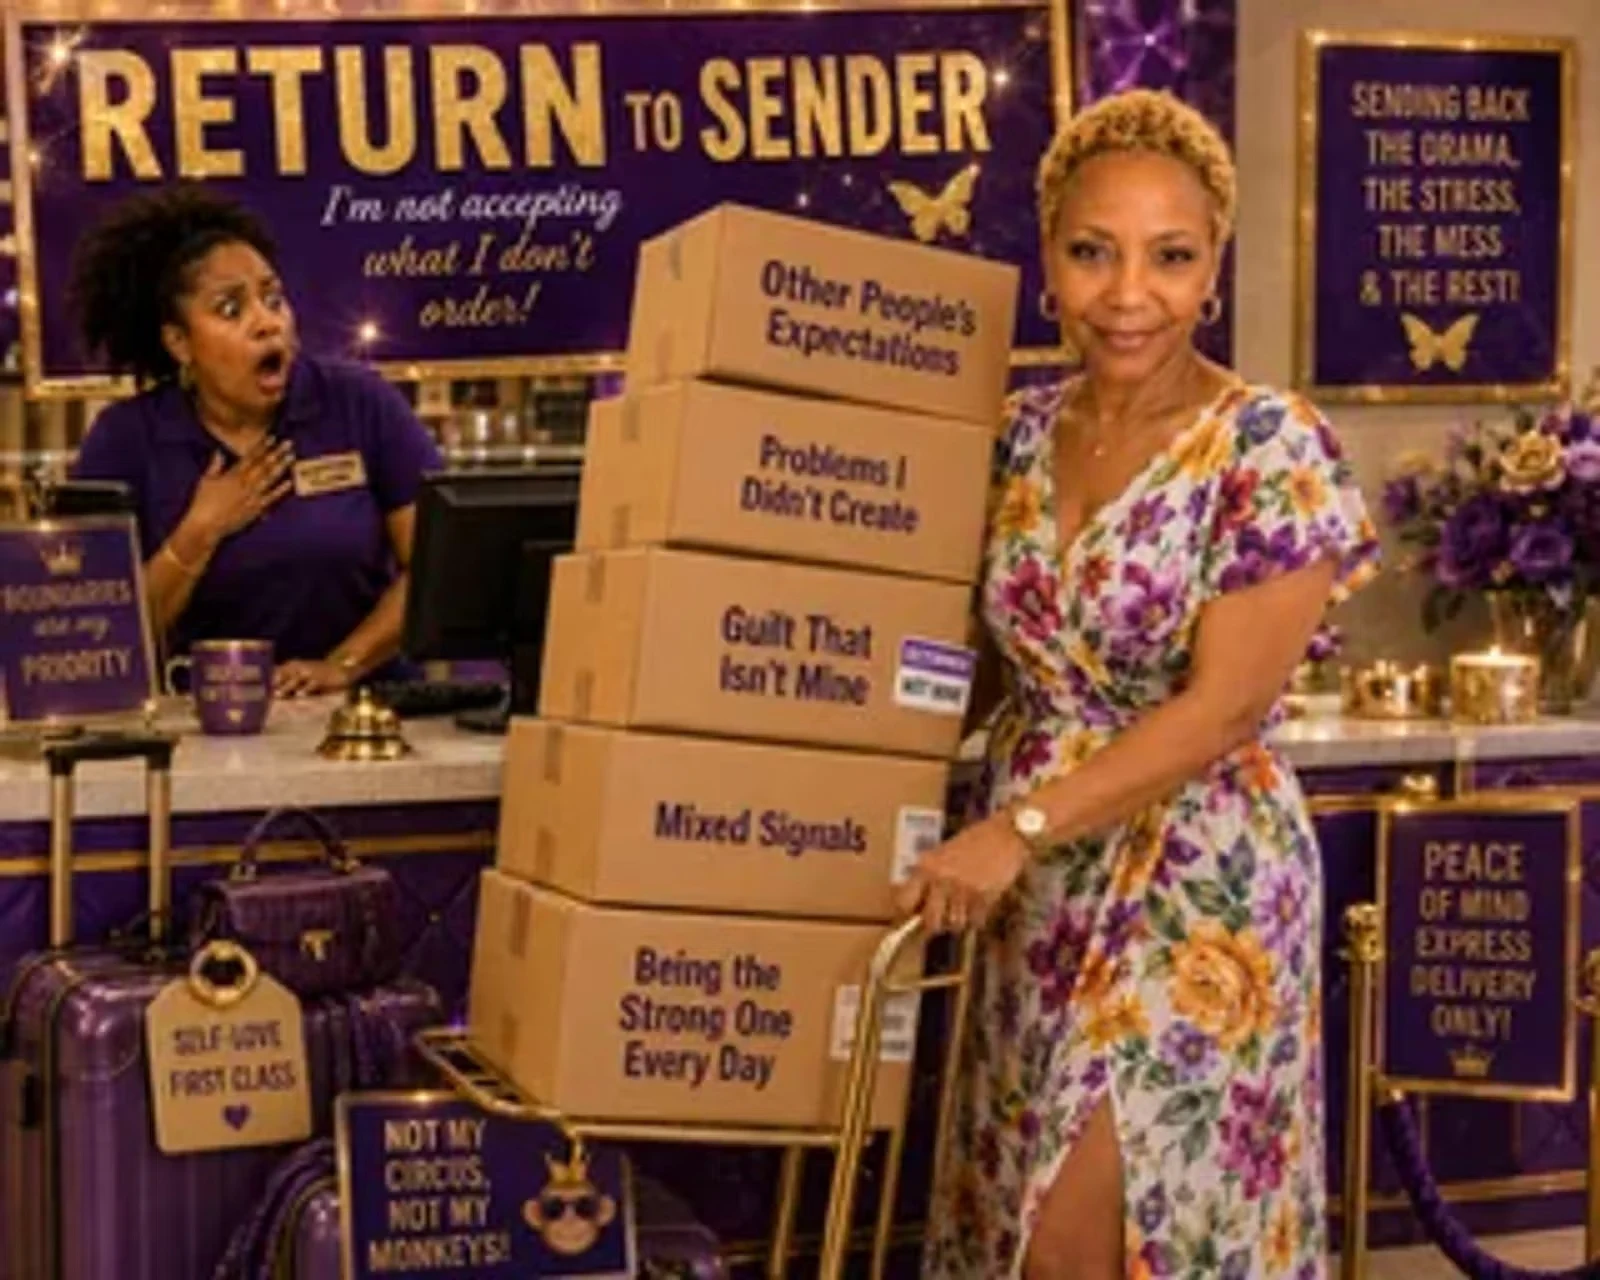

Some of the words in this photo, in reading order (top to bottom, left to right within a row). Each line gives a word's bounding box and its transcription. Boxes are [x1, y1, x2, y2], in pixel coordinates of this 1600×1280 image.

[80, 42, 607, 181] RETURN
[625, 90, 683, 152] TO
[698, 50, 991, 161] SENDER
[1351, 81, 1461, 119] SENDING
[1465, 86, 1530, 121] BACK
[1365, 131, 1413, 166] THE
[320, 184, 383, 226] I'm
[394, 188, 455, 222] not
[460, 184, 622, 232] accepting
[1364, 178, 1412, 211] THE
[1420, 179, 1521, 215] STRESS,
[363, 234, 461, 277] what
[468, 234, 496, 275] I
[500, 230, 596, 271] don't
[1378, 225, 1425, 257] THE
[1435, 225, 1502, 257] MESS
[419, 280, 542, 328] order!
[761, 260, 852, 309] Other
[861, 279, 977, 337] People's
[1360, 271, 1381, 306] &
[1392, 270, 1440, 304] THE
[1446, 270, 1520, 302] REST!
[767, 309, 960, 375] Expectations
[760, 434, 888, 486] Problems
[896, 456, 907, 490] I
[741, 476, 822, 520] Didn't
[830, 489, 920, 534] Create
[723, 605, 795, 649] Guilt
[808, 615, 872, 659] That
[22, 648, 131, 686] PRIORITY
[720, 655, 786, 697] Isn't
[795, 664, 869, 705] Mine
[655, 801, 751, 844] Mixed
[759, 809, 866, 857] Signals
[1424, 842, 1525, 881] PEACE
[1419, 889, 1452, 921] OF
[1459, 889, 1530, 921] MIND
[1415, 928, 1532, 961] EXPRESS
[635, 946, 722, 995] Being
[733, 955, 781, 990] the
[1410, 967, 1537, 1001] DELIVERY
[619, 993, 725, 1041] Strong
[736, 1000, 792, 1039] One
[1430, 1005, 1512, 1039] ONLY!
[170, 1067, 225, 1097] FIRST
[231, 1059, 295, 1092] CLASS
[624, 1041, 710, 1089] Every
[719, 1044, 776, 1091] Day
[384, 1120, 437, 1151] NOT
[448, 1119, 487, 1149] MY
[385, 1157, 490, 1192] CIRCUS,
[390, 1200, 440, 1232] NOT
[450, 1195, 490, 1227] MY
[368, 1233, 511, 1273] MONKEYS!
